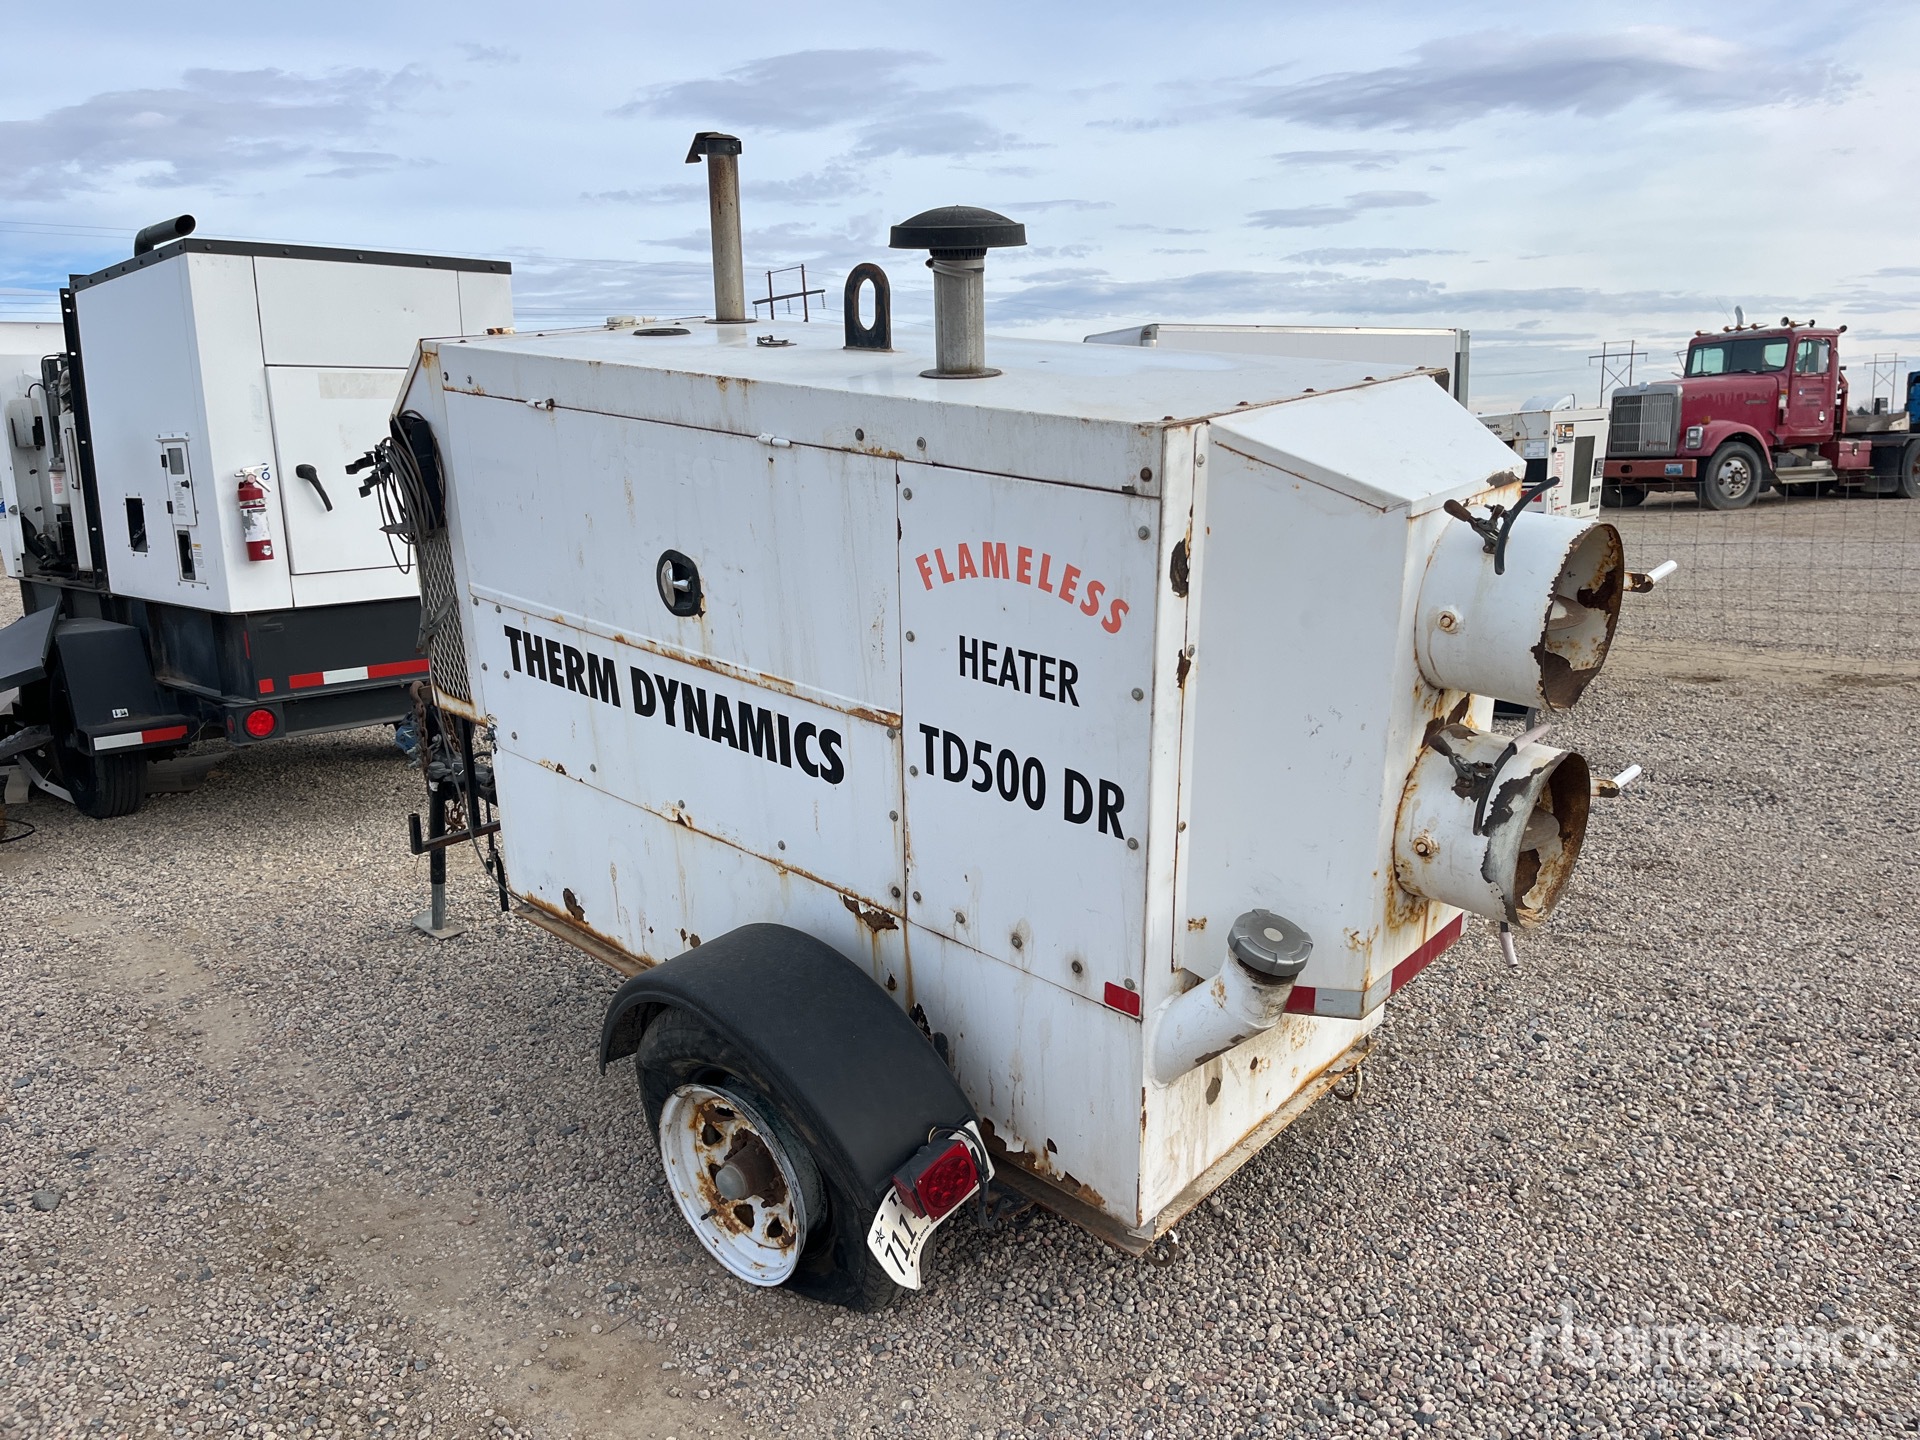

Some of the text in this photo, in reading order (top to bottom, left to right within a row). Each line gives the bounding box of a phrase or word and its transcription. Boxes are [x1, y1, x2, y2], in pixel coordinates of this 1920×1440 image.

[915, 541, 1130, 634] FLAMELESS
[503, 624, 845, 785] THERM DYNAMICS
[958, 635, 1080, 708] HEATER
[919, 722, 1125, 840] TD500 DR
